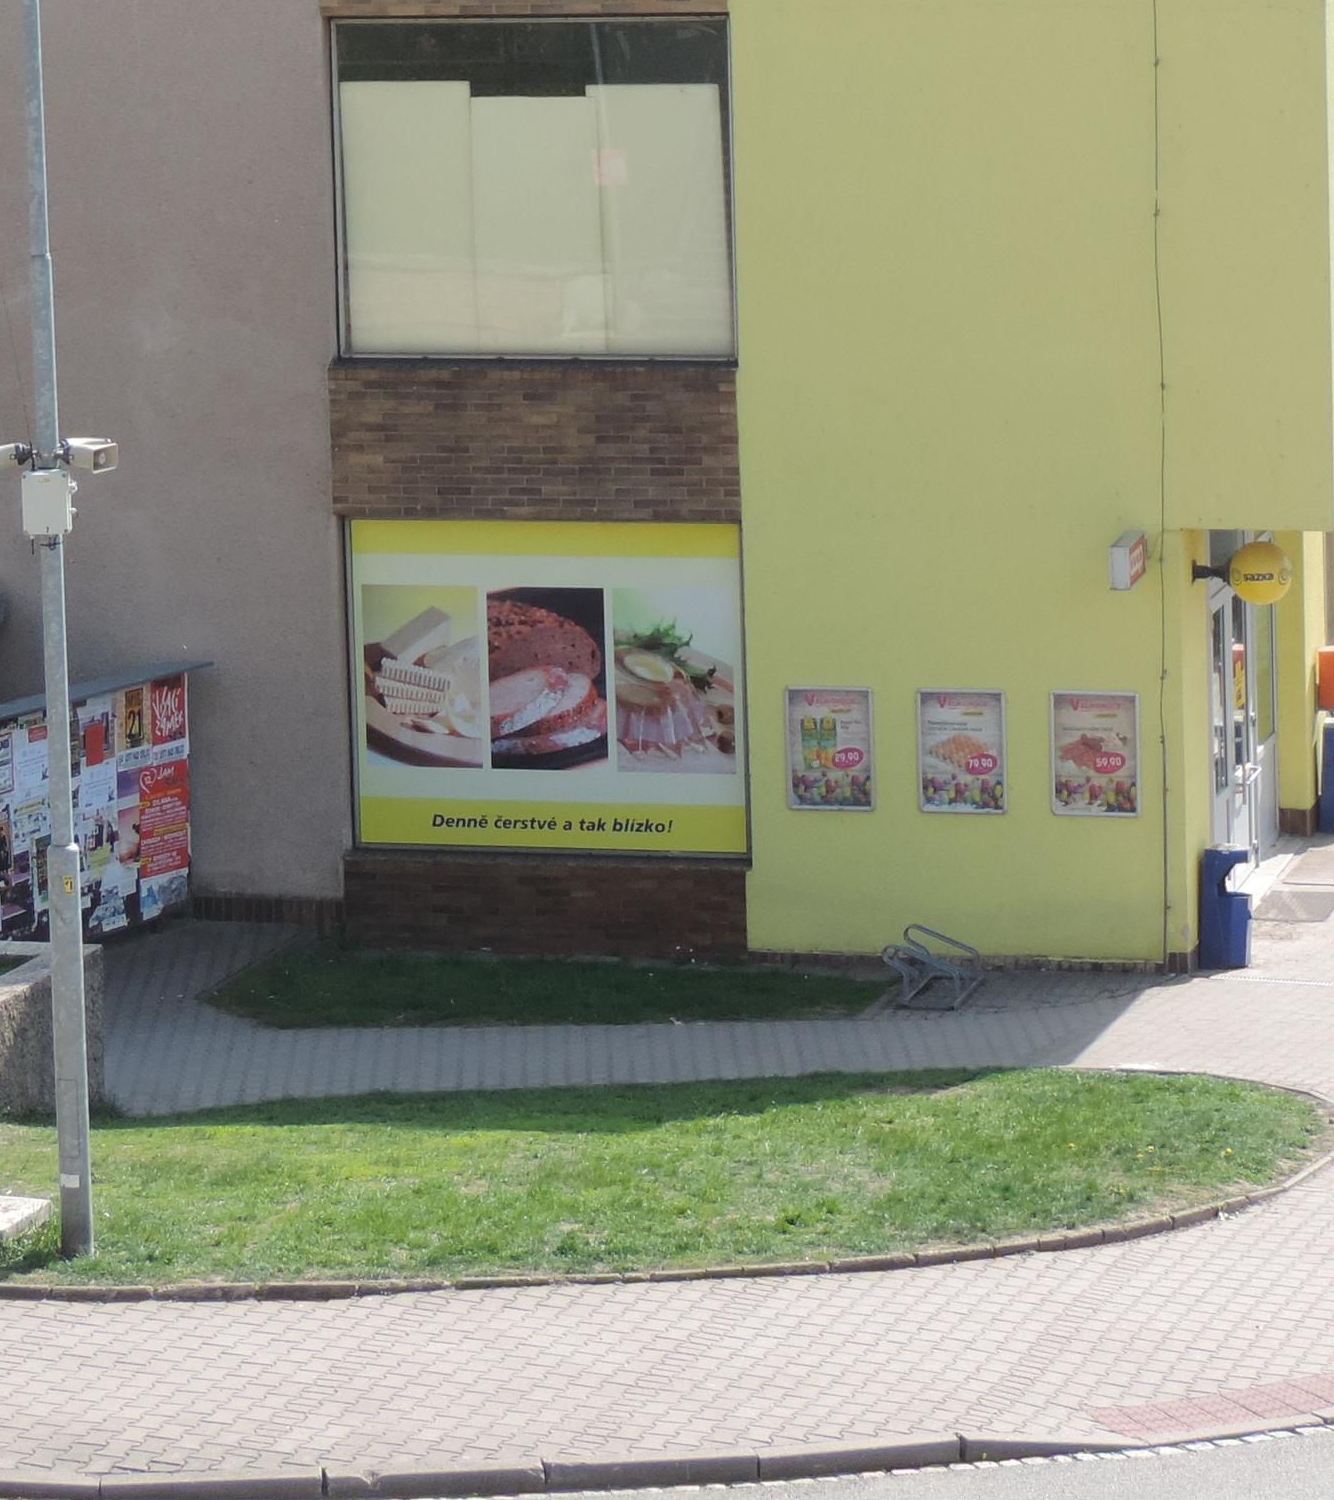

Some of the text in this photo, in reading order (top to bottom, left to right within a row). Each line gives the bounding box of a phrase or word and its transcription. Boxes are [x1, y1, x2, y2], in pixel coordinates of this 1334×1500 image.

[431, 813, 675, 834] Denně čerstvé a tak blízko!
